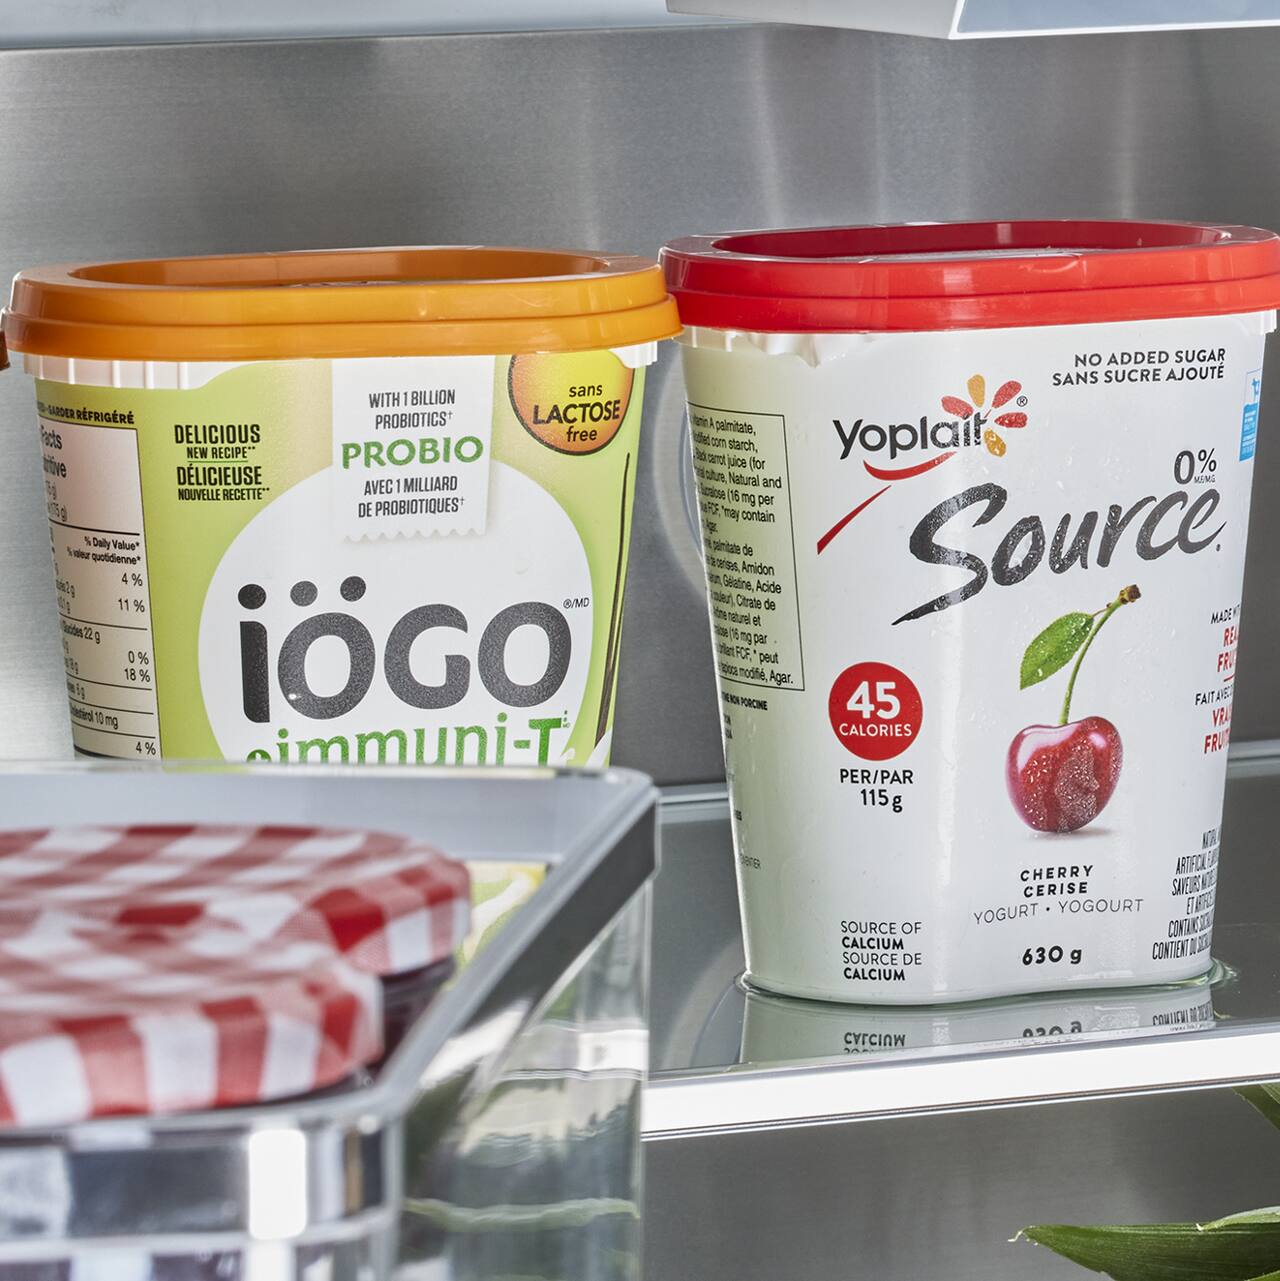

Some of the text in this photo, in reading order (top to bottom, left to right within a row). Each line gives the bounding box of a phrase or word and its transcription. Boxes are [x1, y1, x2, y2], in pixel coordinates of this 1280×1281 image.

[1074, 348, 1227, 368] NO ADDED SUGAR
[1052, 363, 1225, 387] SANS SUCRE AJOUTÉ
[369, 389, 457, 409] WITH 1 BILLION
[569, 384, 603, 398] sans
[76, 407, 135, 425] RÉFRIGÉRÉ
[532, 400, 621, 425] LACTOSE
[174, 423, 261, 445] DELICIOUS
[566, 425, 598, 442] free
[716, 419, 757, 437] palmitate,
[187, 446, 209, 460] NEW
[341, 435, 484, 470] PROBIO
[728, 438, 759, 453] starch,
[727, 454, 766, 472] juice (for
[1174, 447, 1217, 485] 0%
[176, 462, 262, 486] DÉLICIEUSE
[728, 471, 782, 489] Natural and
[178, 488, 222, 502] NOUVELLE
[364, 475, 458, 497] AVEC 1 MILLIARD
[758, 494, 774, 508] per
[358, 502, 373, 519] DE
[741, 509, 776, 523] contain
[93, 536, 111, 550] Daily
[890, 482, 1228, 626] Source
[741, 560, 775, 576] Amidon
[756, 579, 782, 594] Acide
[118, 598, 130, 611] 11
[1210, 607, 1233, 625] MADE
[753, 632, 768, 646] par
[759, 651, 779, 665] peut
[124, 668, 136, 681] 18
[769, 669, 794, 686] Agar.
[740, 696, 768, 711] PORCINE
[846, 680, 901, 720] 45
[1194, 689, 1215, 707] FAIT
[838, 722, 913, 738] CALORIES
[840, 768, 914, 786] PER/PAR
[860, 788, 903, 813] 115 g
[1020, 864, 1094, 883] CHERRY
[1023, 882, 1088, 898] CERISE
[973, 898, 1144, 925] YOGURT YOGOURT
[840, 920, 923, 936] SOURCE OF
[1168, 915, 1200, 938] CONTAINS
[841, 935, 905, 951] CALCIUM
[1152, 938, 1190, 960] CONTIENT
[842, 951, 923, 966] SOURCE DE
[1022, 945, 1083, 966] 630 g
[843, 967, 906, 982] CALCIUM
